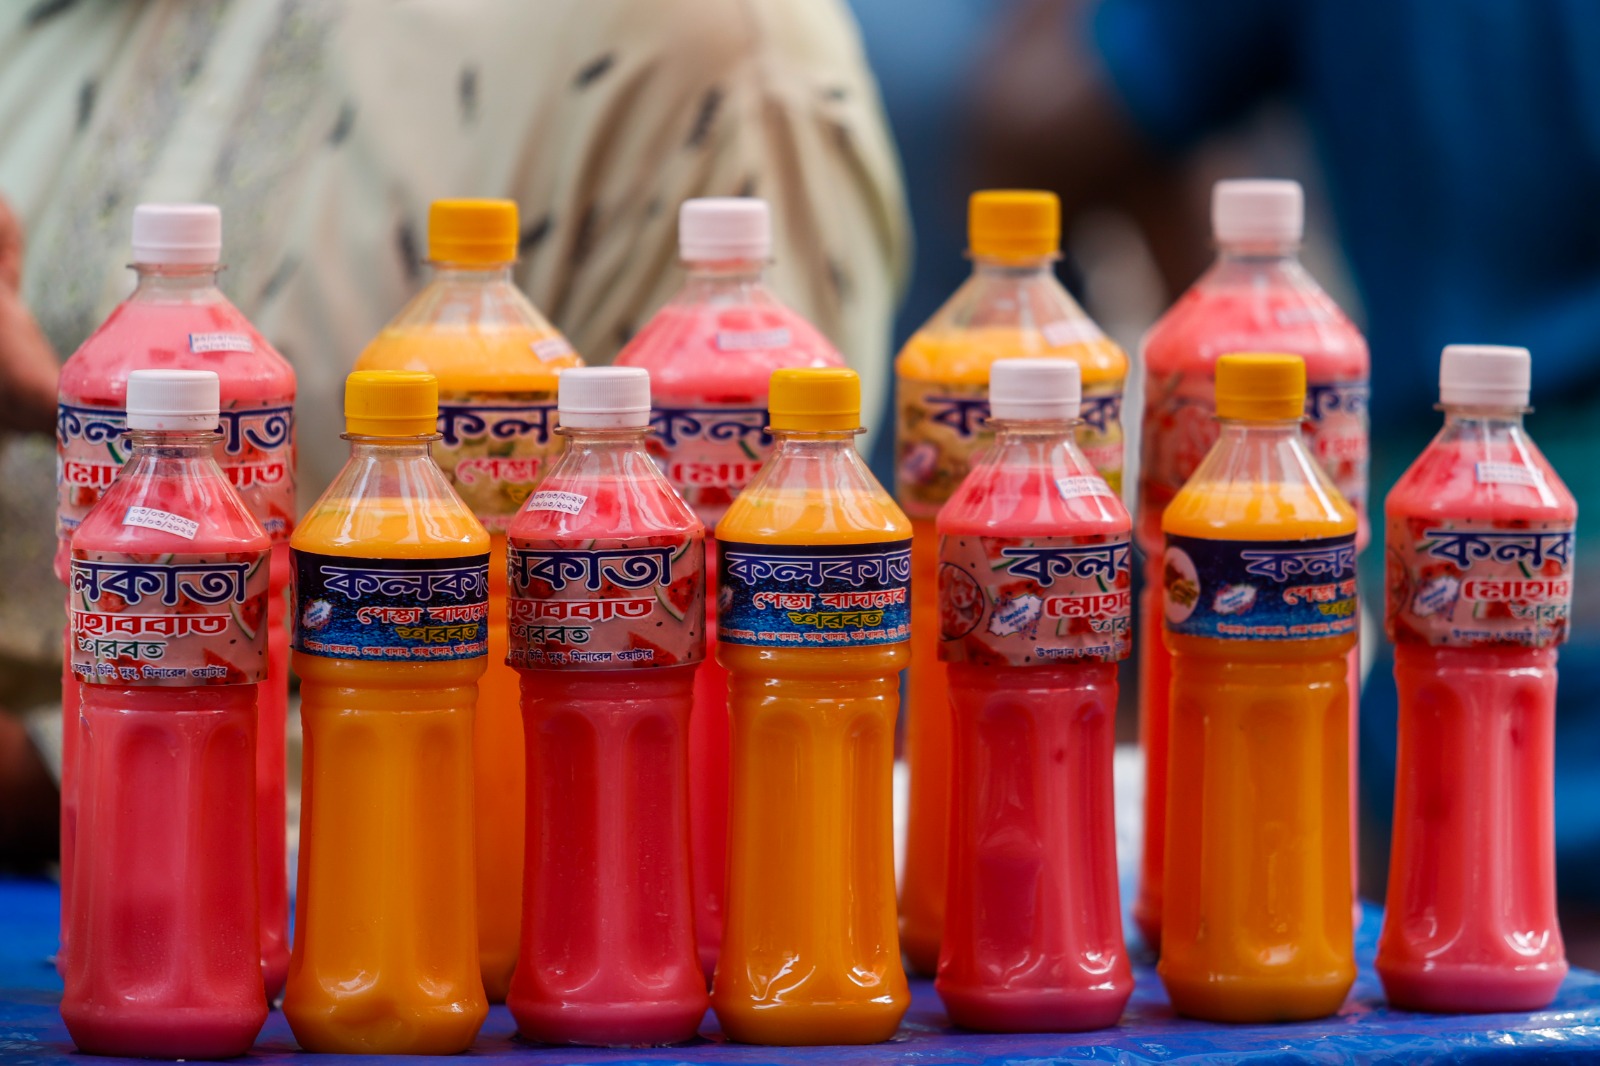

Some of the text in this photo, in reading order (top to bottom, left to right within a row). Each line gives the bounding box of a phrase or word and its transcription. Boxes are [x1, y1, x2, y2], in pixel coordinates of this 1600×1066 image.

[753, 591, 815, 610] পেস্তা
[356, 605, 424, 625] পেস্তা
[787, 610, 884, 629] শরবত
[394, 623, 479, 644] শরবত
[511, 624, 594, 645] শরবত
[78, 638, 169, 660] শরবত
[569, 649, 613, 664] মিনারেল
[616, 648, 655, 663] ওয়াটার
[97, 663, 118, 679] চিনি,
[142, 665, 187, 680] মিনারেল
[191, 665, 228, 680] ওয়াটার
